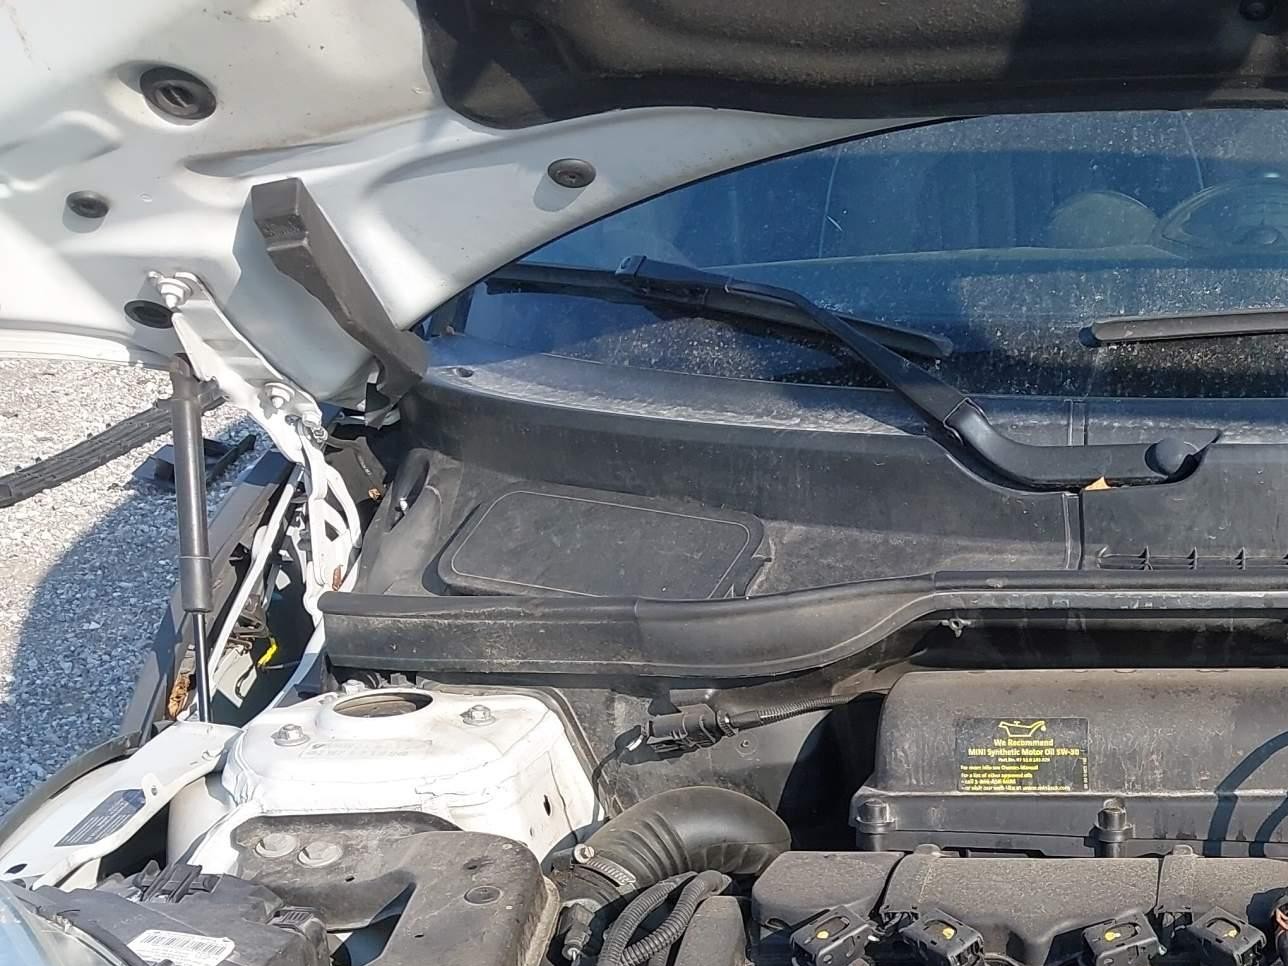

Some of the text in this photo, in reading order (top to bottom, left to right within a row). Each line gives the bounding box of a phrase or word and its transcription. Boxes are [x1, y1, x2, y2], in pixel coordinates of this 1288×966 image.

[993, 739, 1054, 747] We Recommend
[968, 748, 986, 756] MINI
[987, 748, 1020, 758] Synthetic
[1021, 748, 1043, 756] Motor
[1044, 748, 1055, 756] Oil
